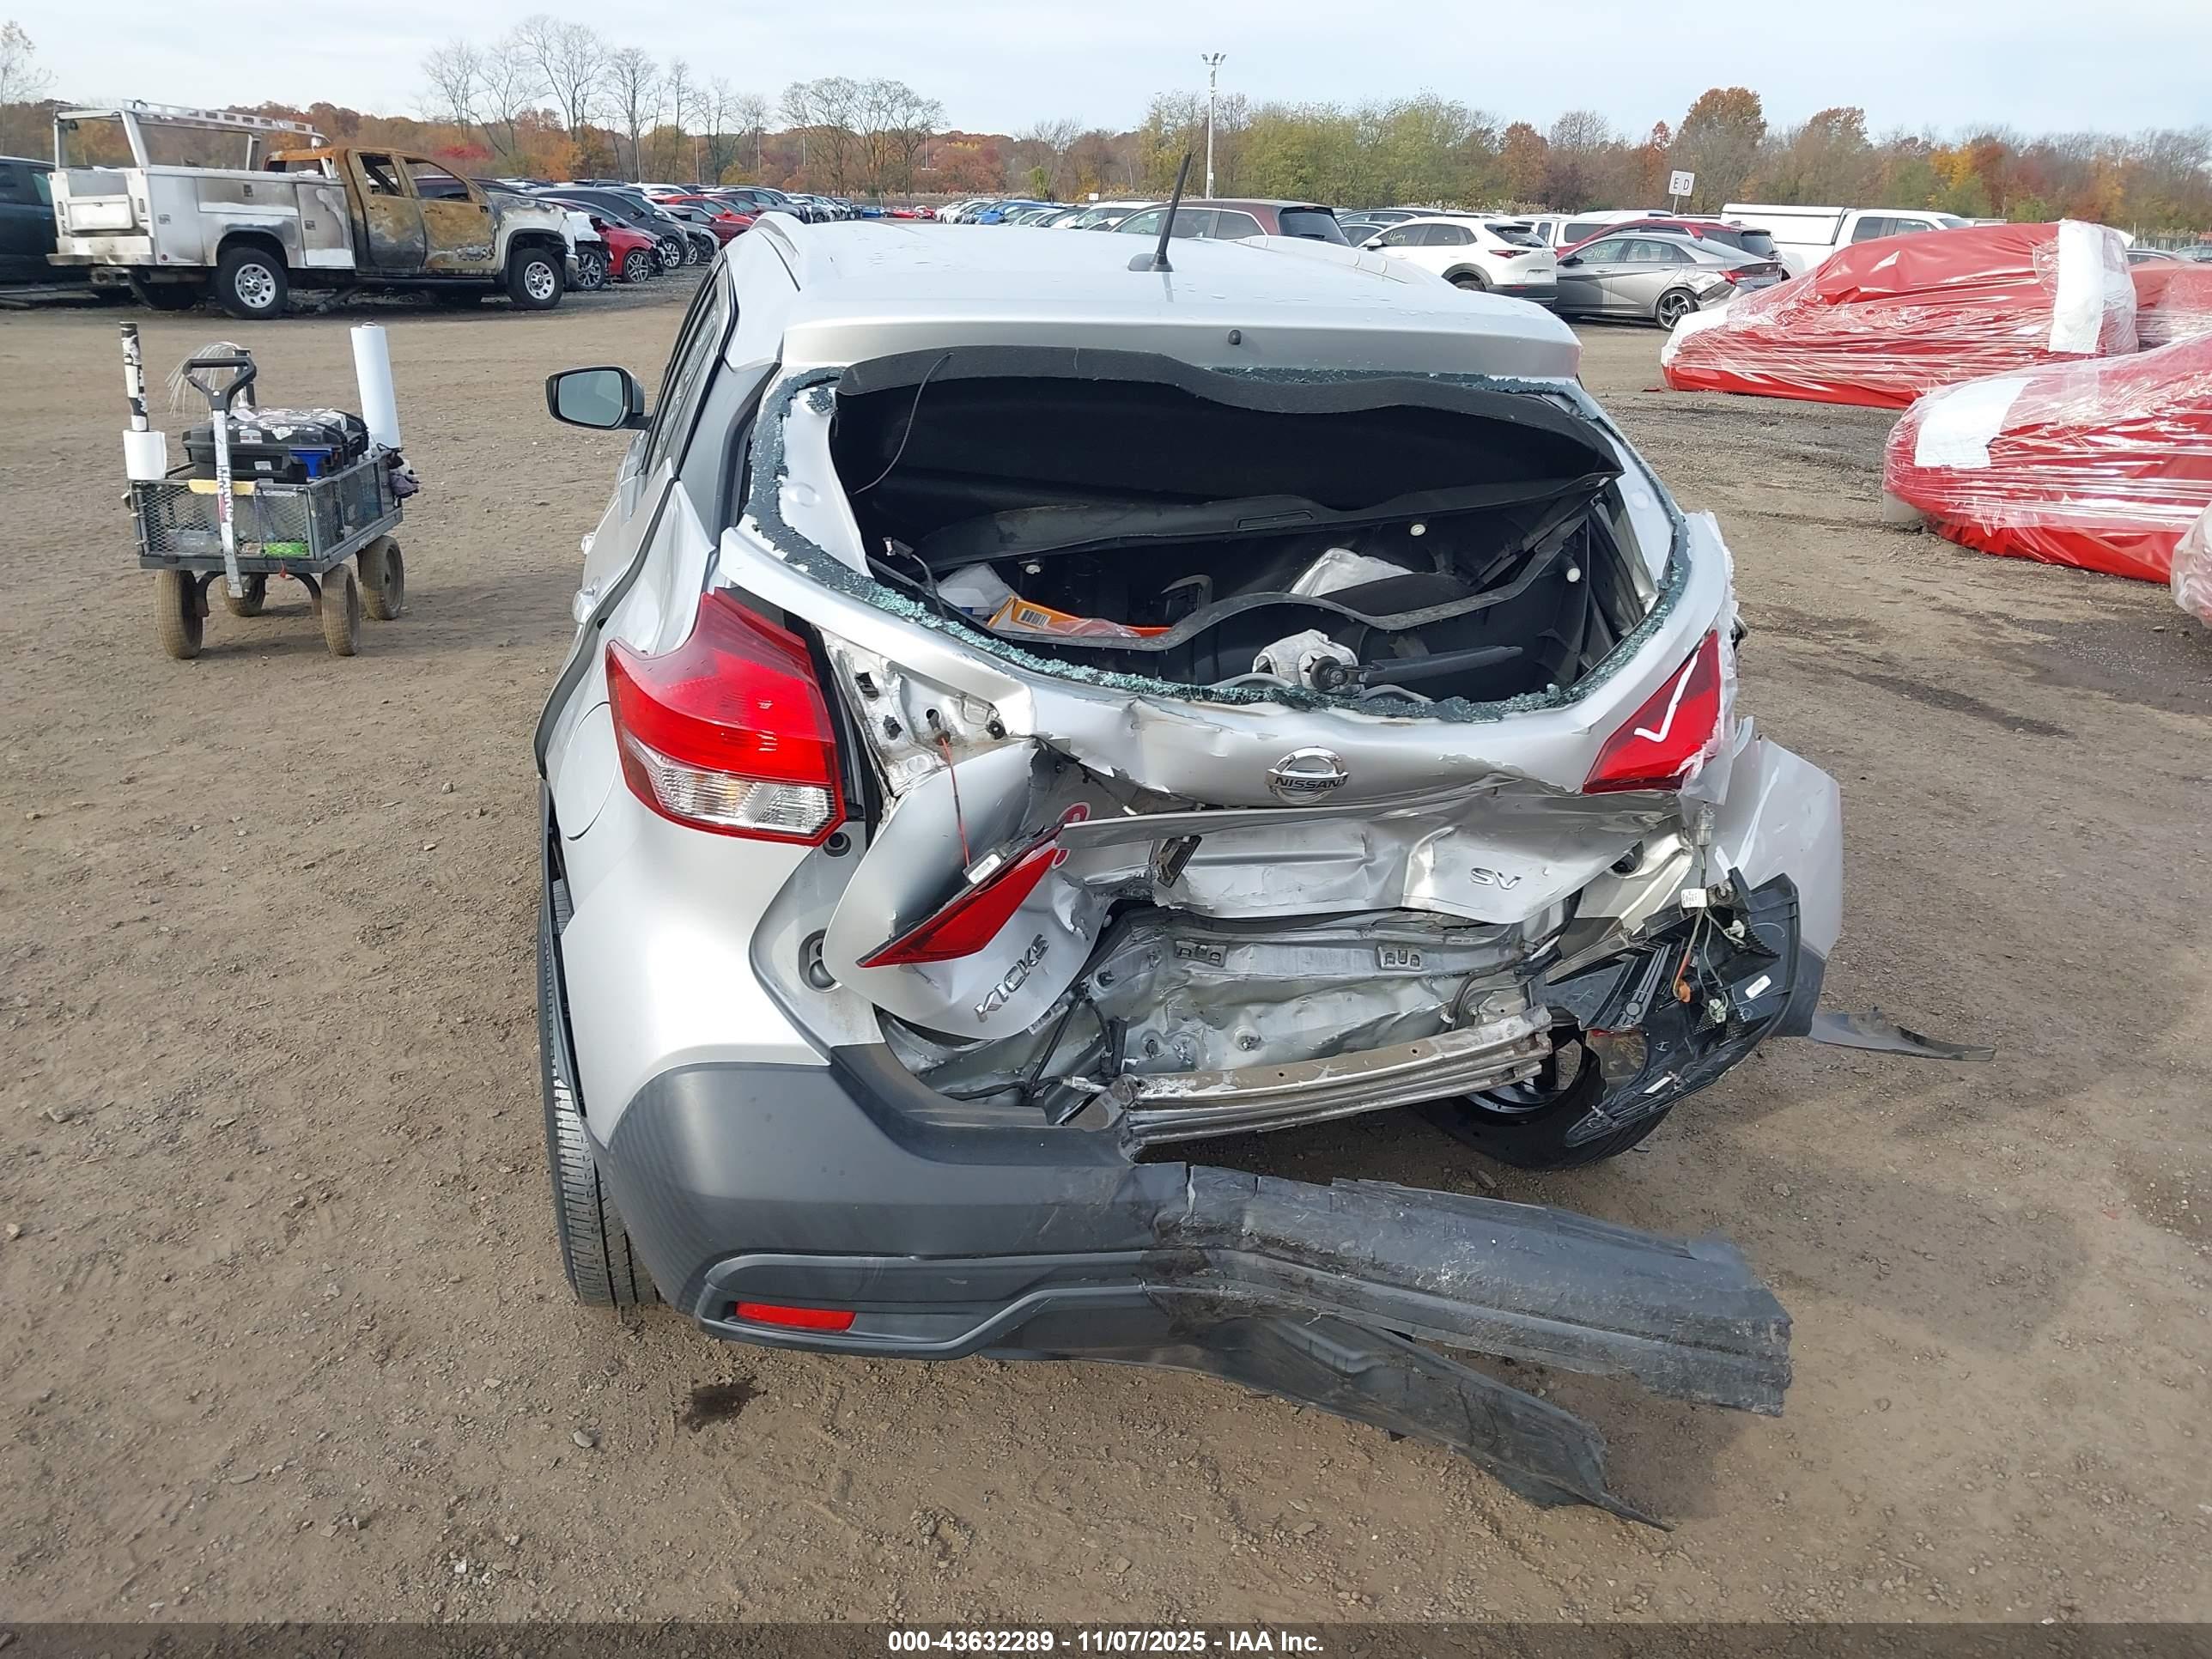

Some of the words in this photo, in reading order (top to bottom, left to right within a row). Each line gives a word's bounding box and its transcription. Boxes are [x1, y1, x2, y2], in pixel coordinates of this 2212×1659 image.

[1274, 776, 1341, 790] NISSAN
[1470, 867, 1523, 890] SV
[973, 933, 1050, 1024] KICKS
